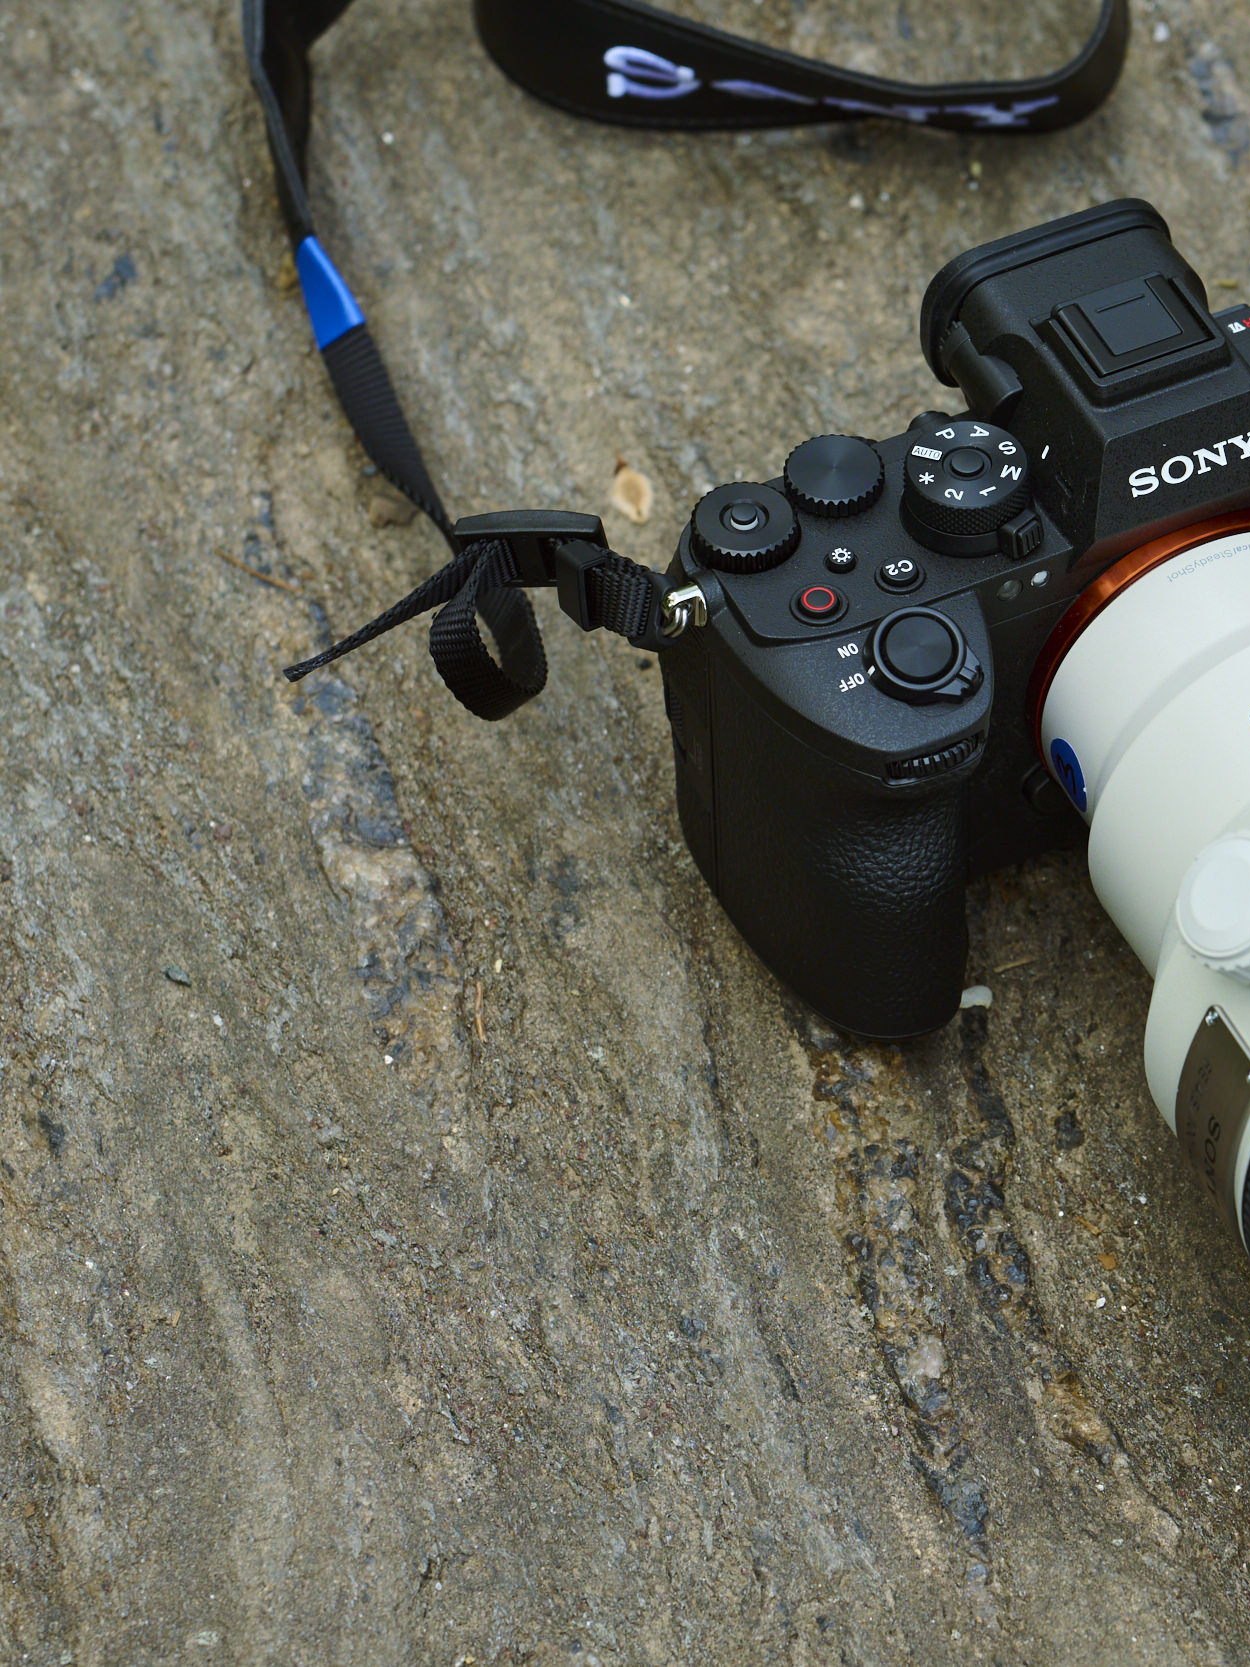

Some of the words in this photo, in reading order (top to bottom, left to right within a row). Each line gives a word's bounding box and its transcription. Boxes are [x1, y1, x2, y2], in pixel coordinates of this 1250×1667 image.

[935, 427, 956, 440] P
[970, 425, 990, 437] A
[911, 445, 943, 461] AUTO
[998, 441, 1017, 455] S
[1000, 464, 1022, 481] M
[944, 488, 964, 501] 2
[885, 559, 914, 576] C2
[837, 642, 859, 659] ON
[838, 672, 865, 693] OFF
